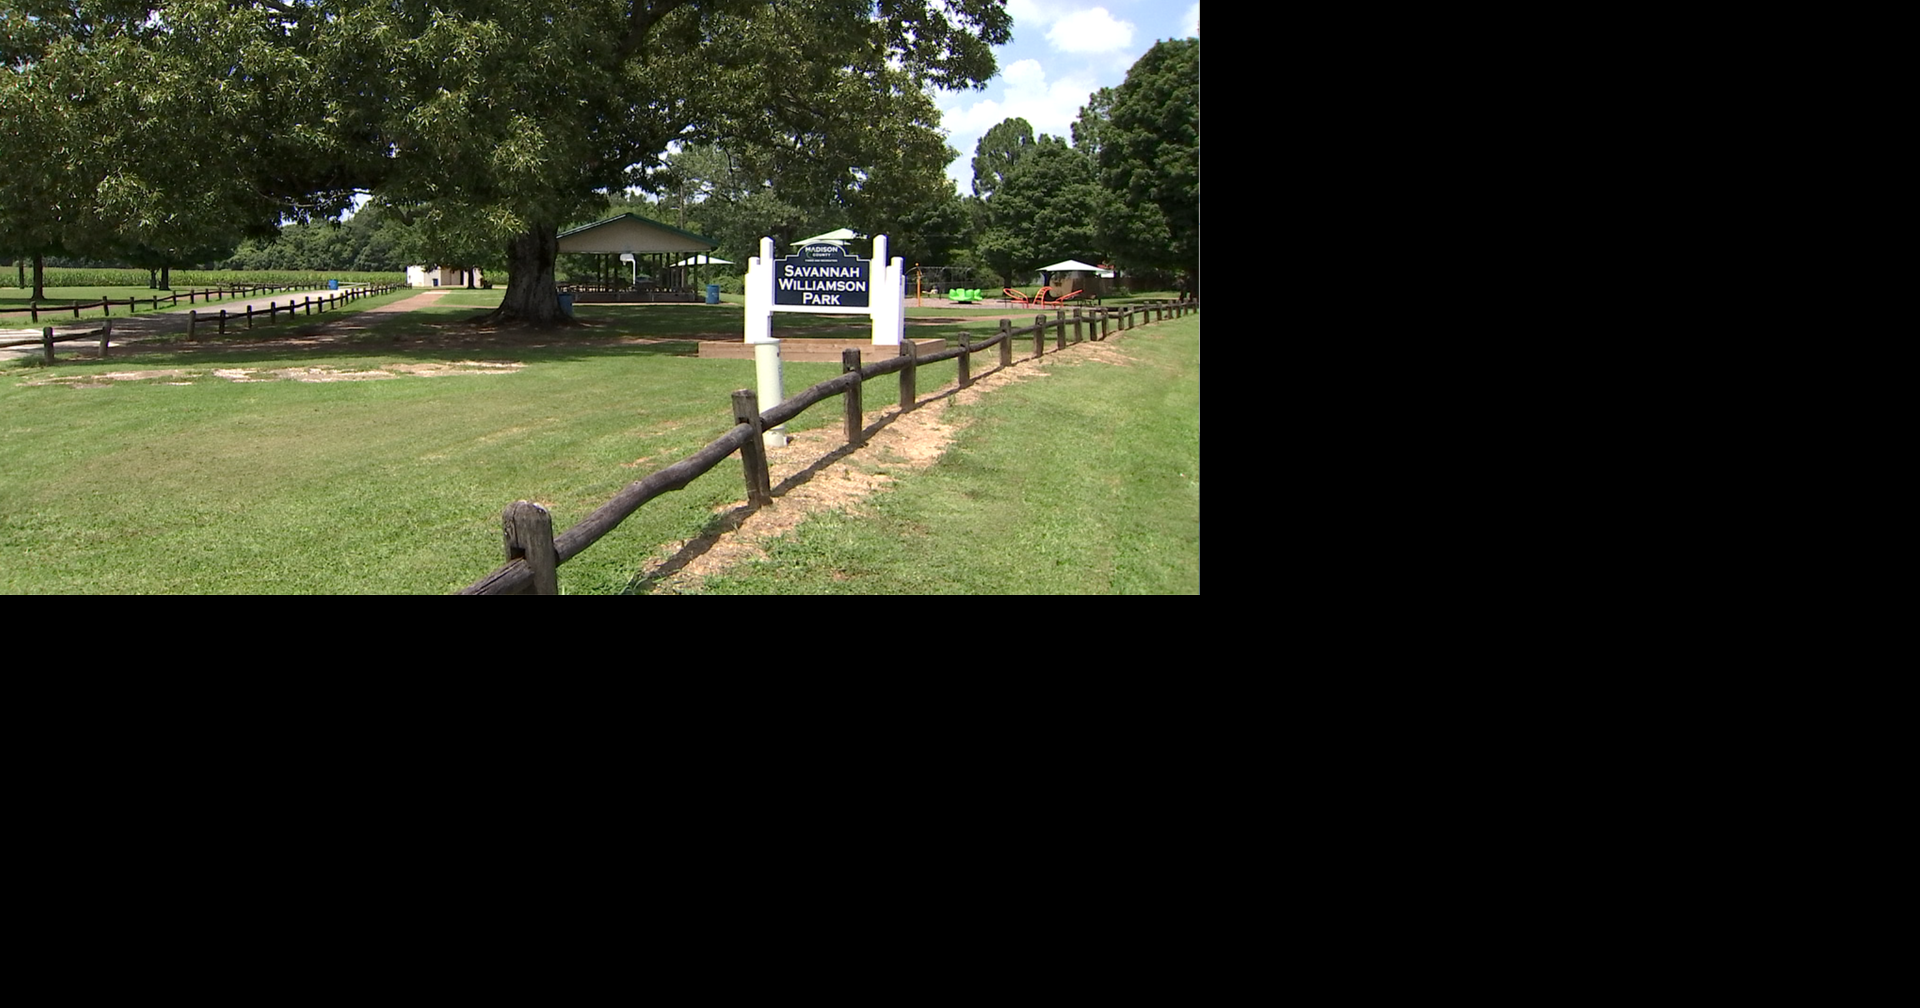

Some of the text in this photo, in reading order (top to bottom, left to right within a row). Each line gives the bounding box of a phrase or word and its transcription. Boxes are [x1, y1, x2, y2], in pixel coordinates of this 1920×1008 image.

[784, 264, 860, 278] SAVANNAH
[778, 278, 866, 292] WILLIAMSON
[803, 292, 841, 305] PARK
